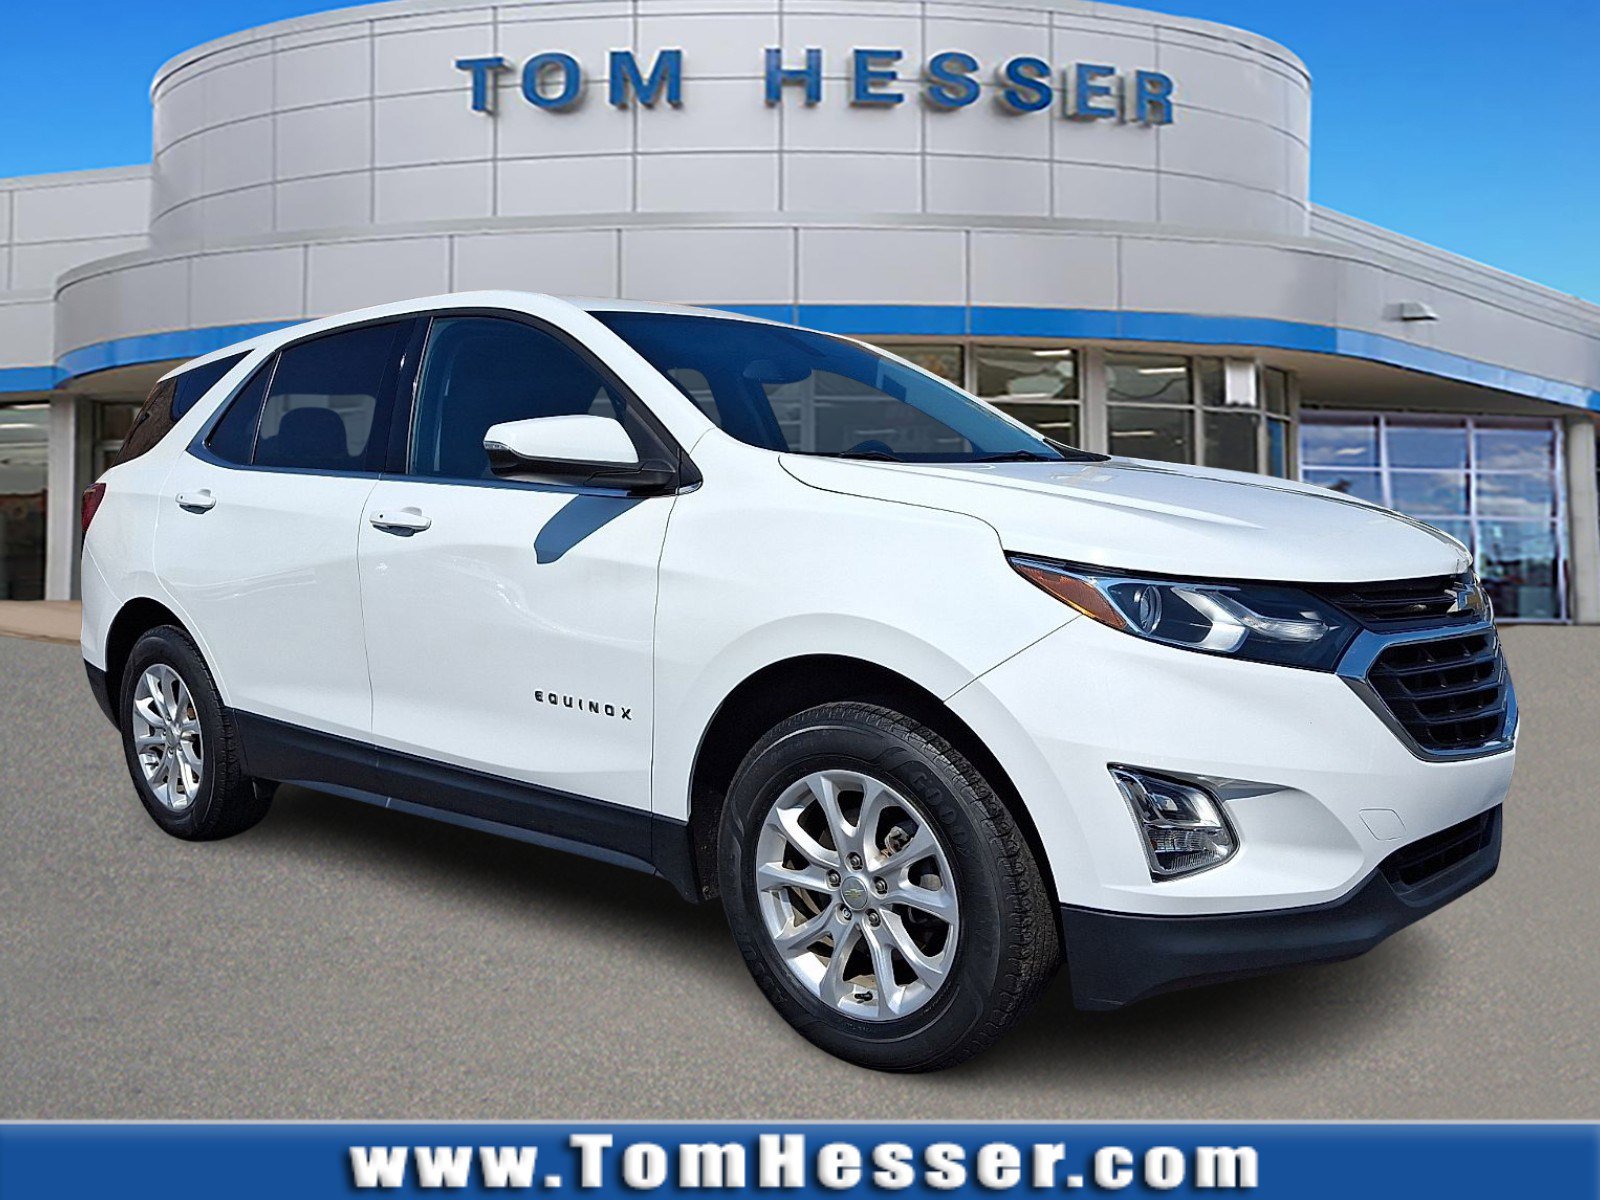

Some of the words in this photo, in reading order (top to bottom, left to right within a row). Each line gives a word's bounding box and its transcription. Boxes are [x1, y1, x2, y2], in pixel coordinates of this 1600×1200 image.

[455, 48, 684, 113] TOM
[766, 48, 1175, 125] HESSER
[534, 690, 632, 720] EQUINOX
